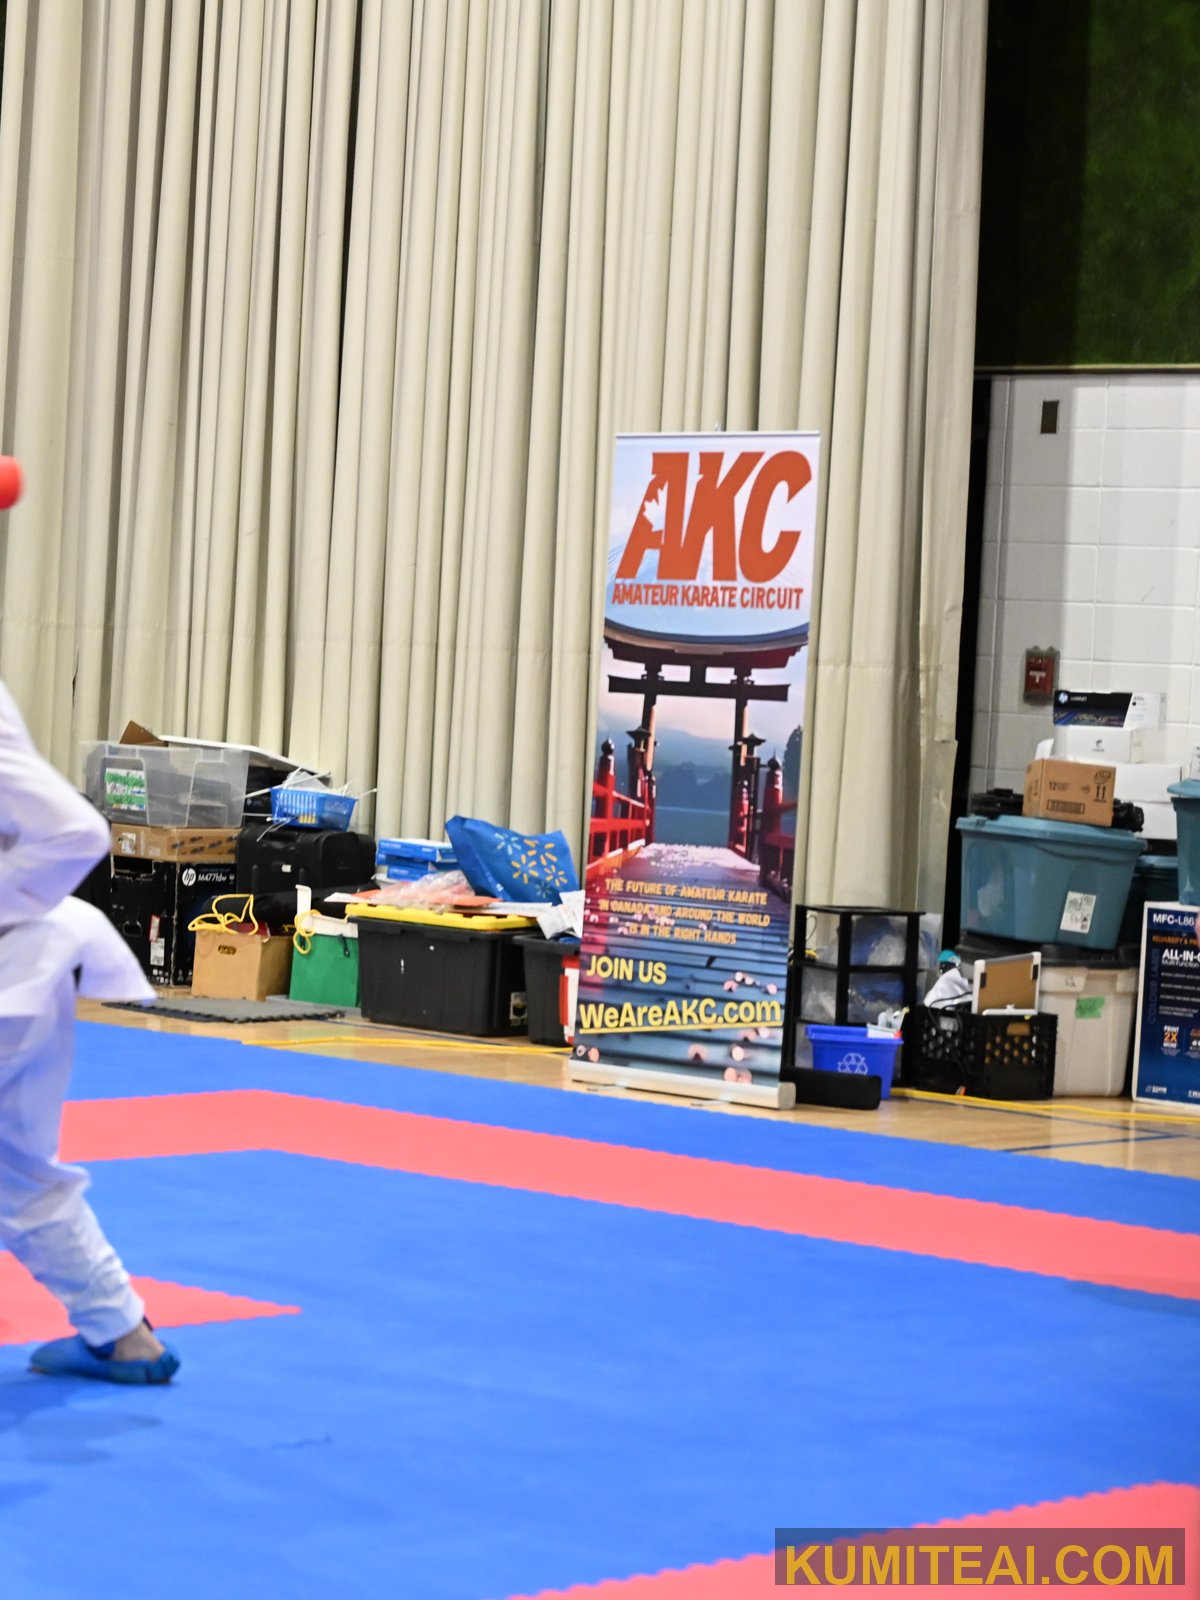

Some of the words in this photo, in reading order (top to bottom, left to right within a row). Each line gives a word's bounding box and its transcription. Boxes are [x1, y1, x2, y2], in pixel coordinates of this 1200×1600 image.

[616, 450, 812, 583] AKC
[612, 585, 678, 605] AMATEUR
[681, 586, 736, 607] KARATE
[740, 587, 804, 610] CIRCUIT
[182, 868, 197, 887] hp
[605, 878, 623, 891] THE
[626, 881, 663, 895] FUTURE
[665, 884, 677, 896] OF
[680, 886, 726, 901] AMATEUR
[728, 890, 767, 905] KARATE
[598, 899, 609, 911] IN
[611, 901, 652, 915] CANADA
[652, 904, 672, 917] AND
[674, 906, 712, 922] AROUND
[716, 909, 734, 923] THE
[737, 911, 770, 927] WORLD
[1152, 913, 1195, 926] MFC-L86
[629, 924, 639, 934] IS
[640, 924, 649, 935] IN
[652, 925, 670, 938] THE
[674, 927, 701, 941] RIGHT
[704, 929, 736, 945] HANDS
[586, 955, 633, 981] JOIN
[638, 961, 668, 985] US
[579, 997, 782, 1031] WeAreAKC.com
[1163, 1032, 1178, 1042] 2X
